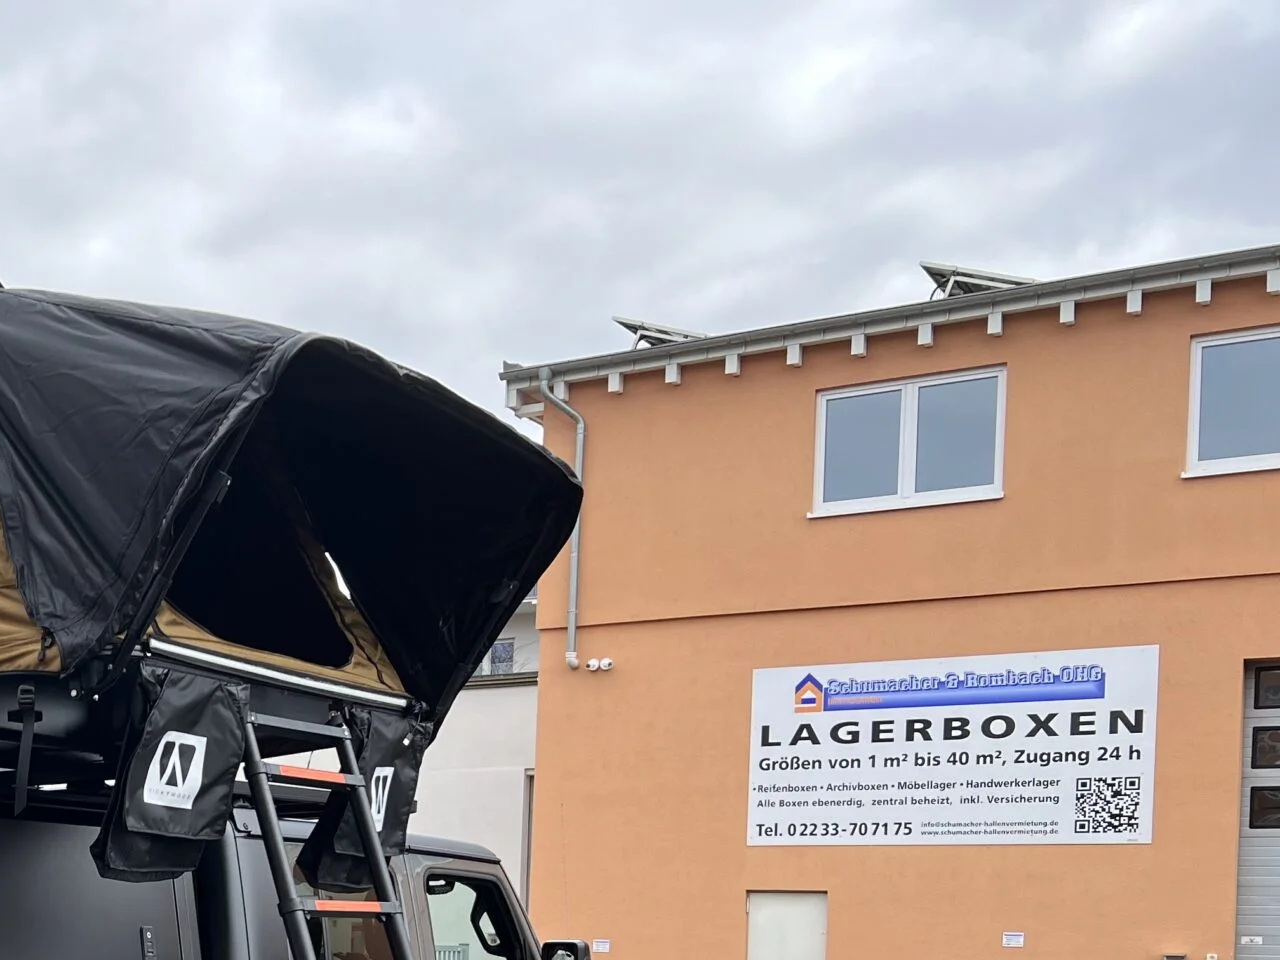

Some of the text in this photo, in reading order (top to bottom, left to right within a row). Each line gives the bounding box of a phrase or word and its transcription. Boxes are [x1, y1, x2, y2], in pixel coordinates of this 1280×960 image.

[827, 663, 1103, 695] Schumacher & Rombach OHG
[760, 708, 1145, 747] LAGERBOXEN
[758, 744, 1141, 771] Größen von 1 m² bis 40 m², Zugang 24 h
[825, 781, 889, 792] Archivboxen
[897, 780, 957, 792] Möbellager
[966, 778, 1061, 789] Handwerkerlager
[756, 799, 776, 808] Alle
[779, 799, 809, 808] Boxen
[871, 797, 908, 806] zentral
[910, 796, 953, 806] beheizt,
[960, 795, 984, 804] inkl.
[986, 794, 1060, 806] Versicherung
[756, 823, 783, 837] Tel.
